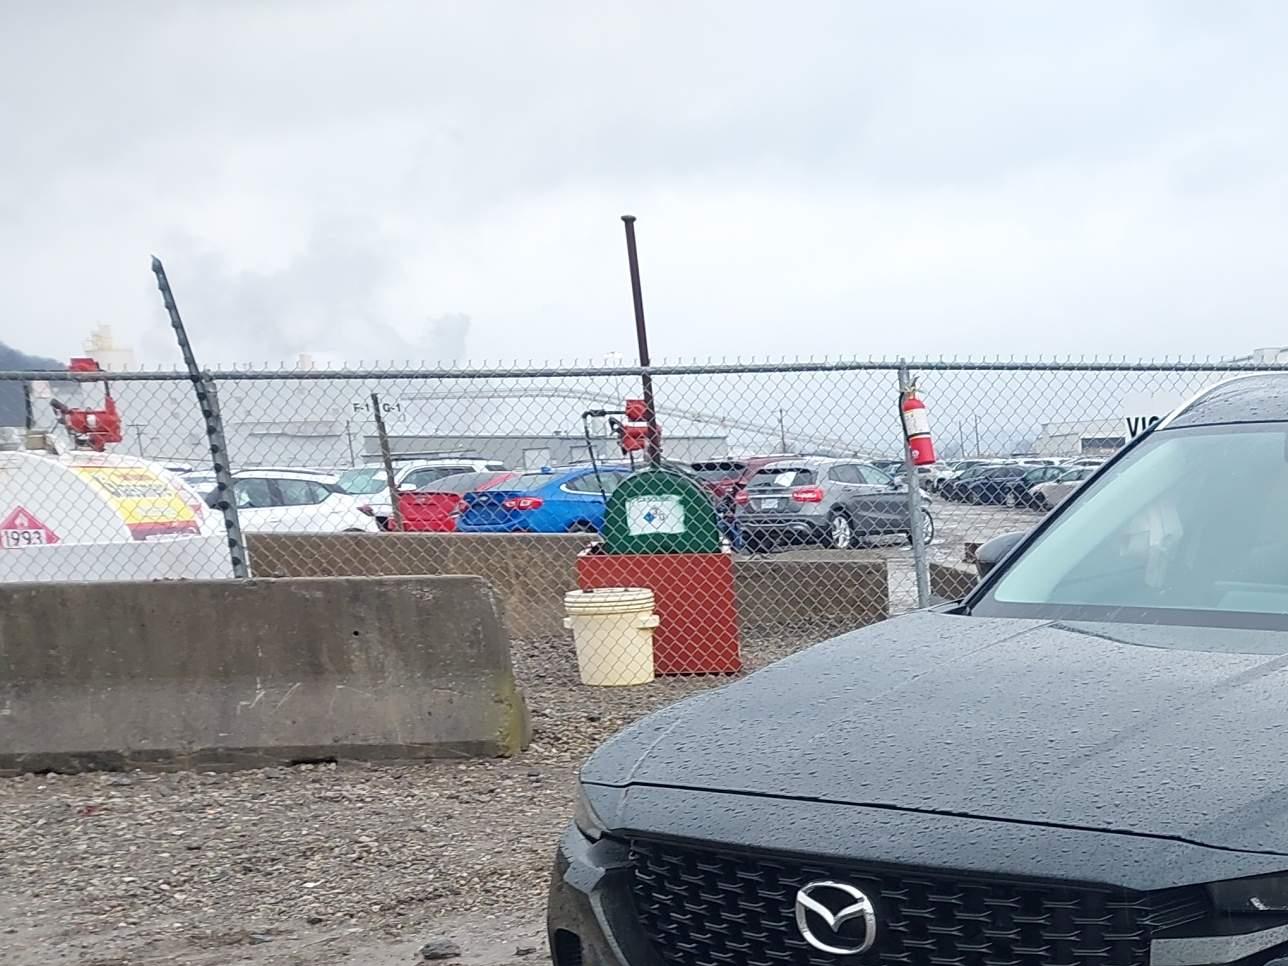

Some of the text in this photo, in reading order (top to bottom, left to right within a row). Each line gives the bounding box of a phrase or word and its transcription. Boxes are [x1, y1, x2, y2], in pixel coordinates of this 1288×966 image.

[353, 402, 370, 412] F-1
[382, 402, 401, 412] G-1
[4, 530, 43, 547] 1993
